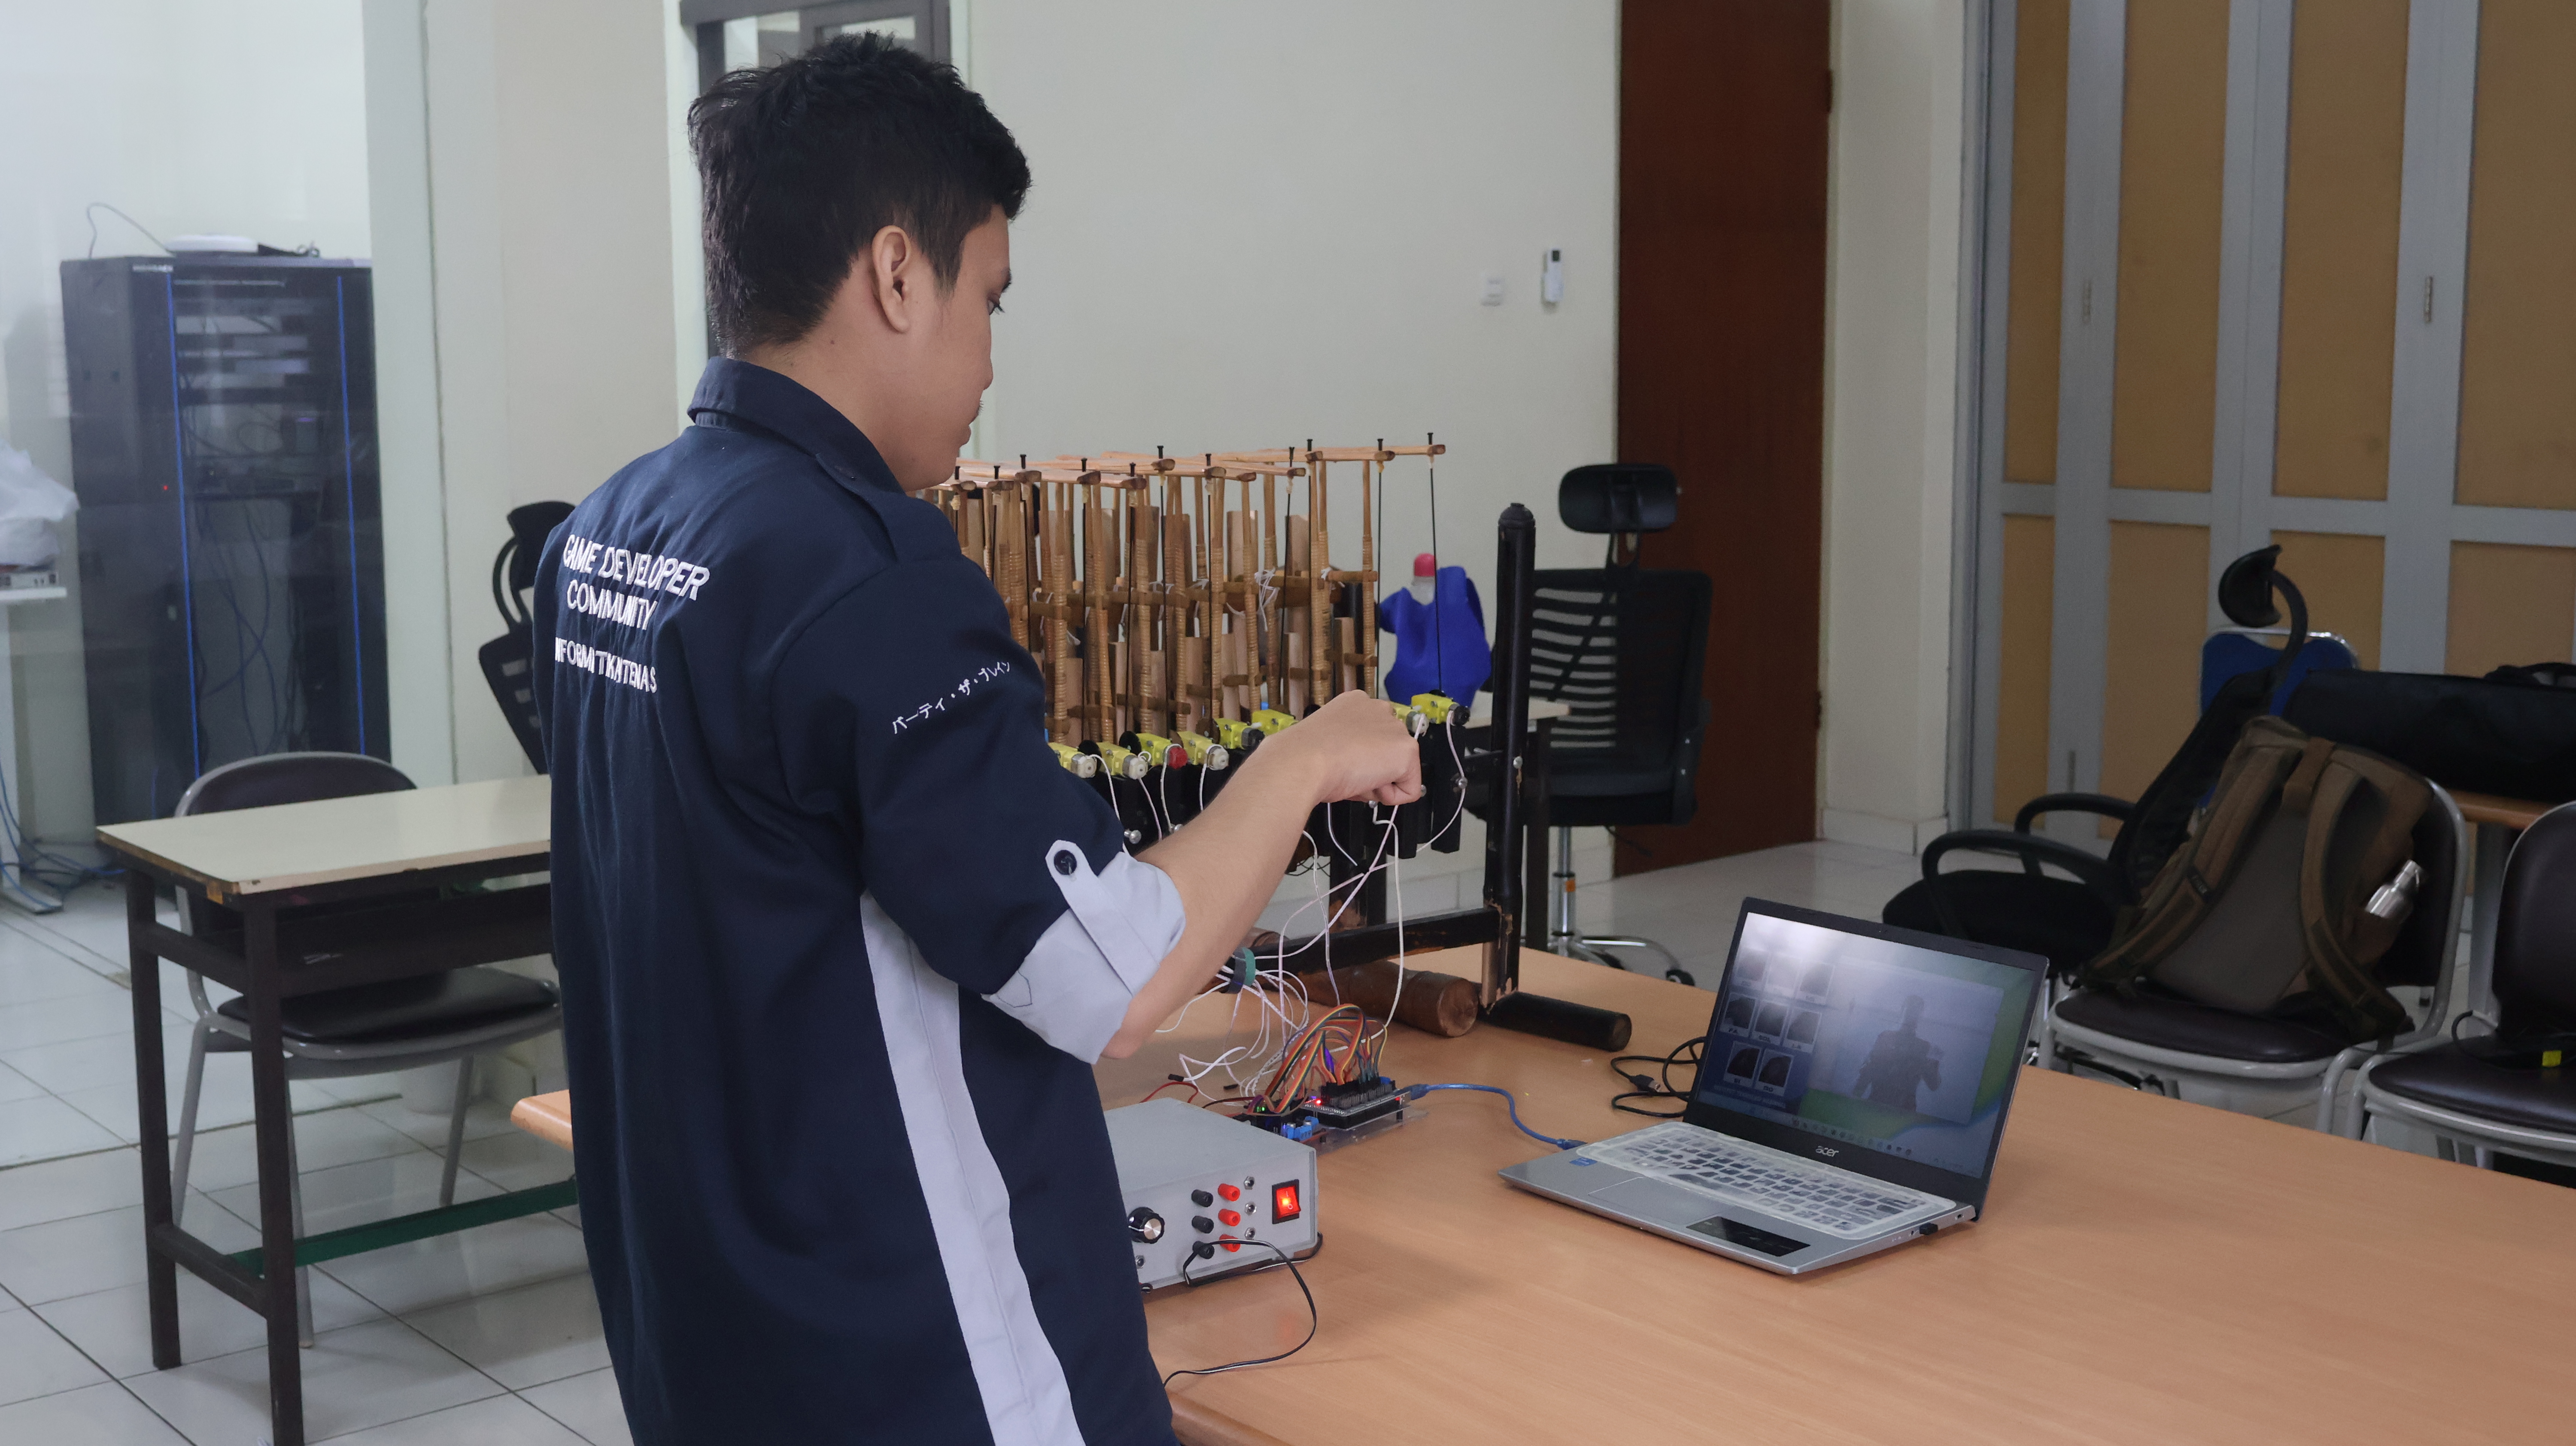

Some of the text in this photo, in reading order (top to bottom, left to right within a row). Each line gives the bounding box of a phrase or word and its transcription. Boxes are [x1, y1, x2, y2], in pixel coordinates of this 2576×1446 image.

[563, 534, 710, 601] GAME DEVELOPER
[567, 579, 658, 630] COMMUNITY
[1815, 1145, 1839, 1157] acer
